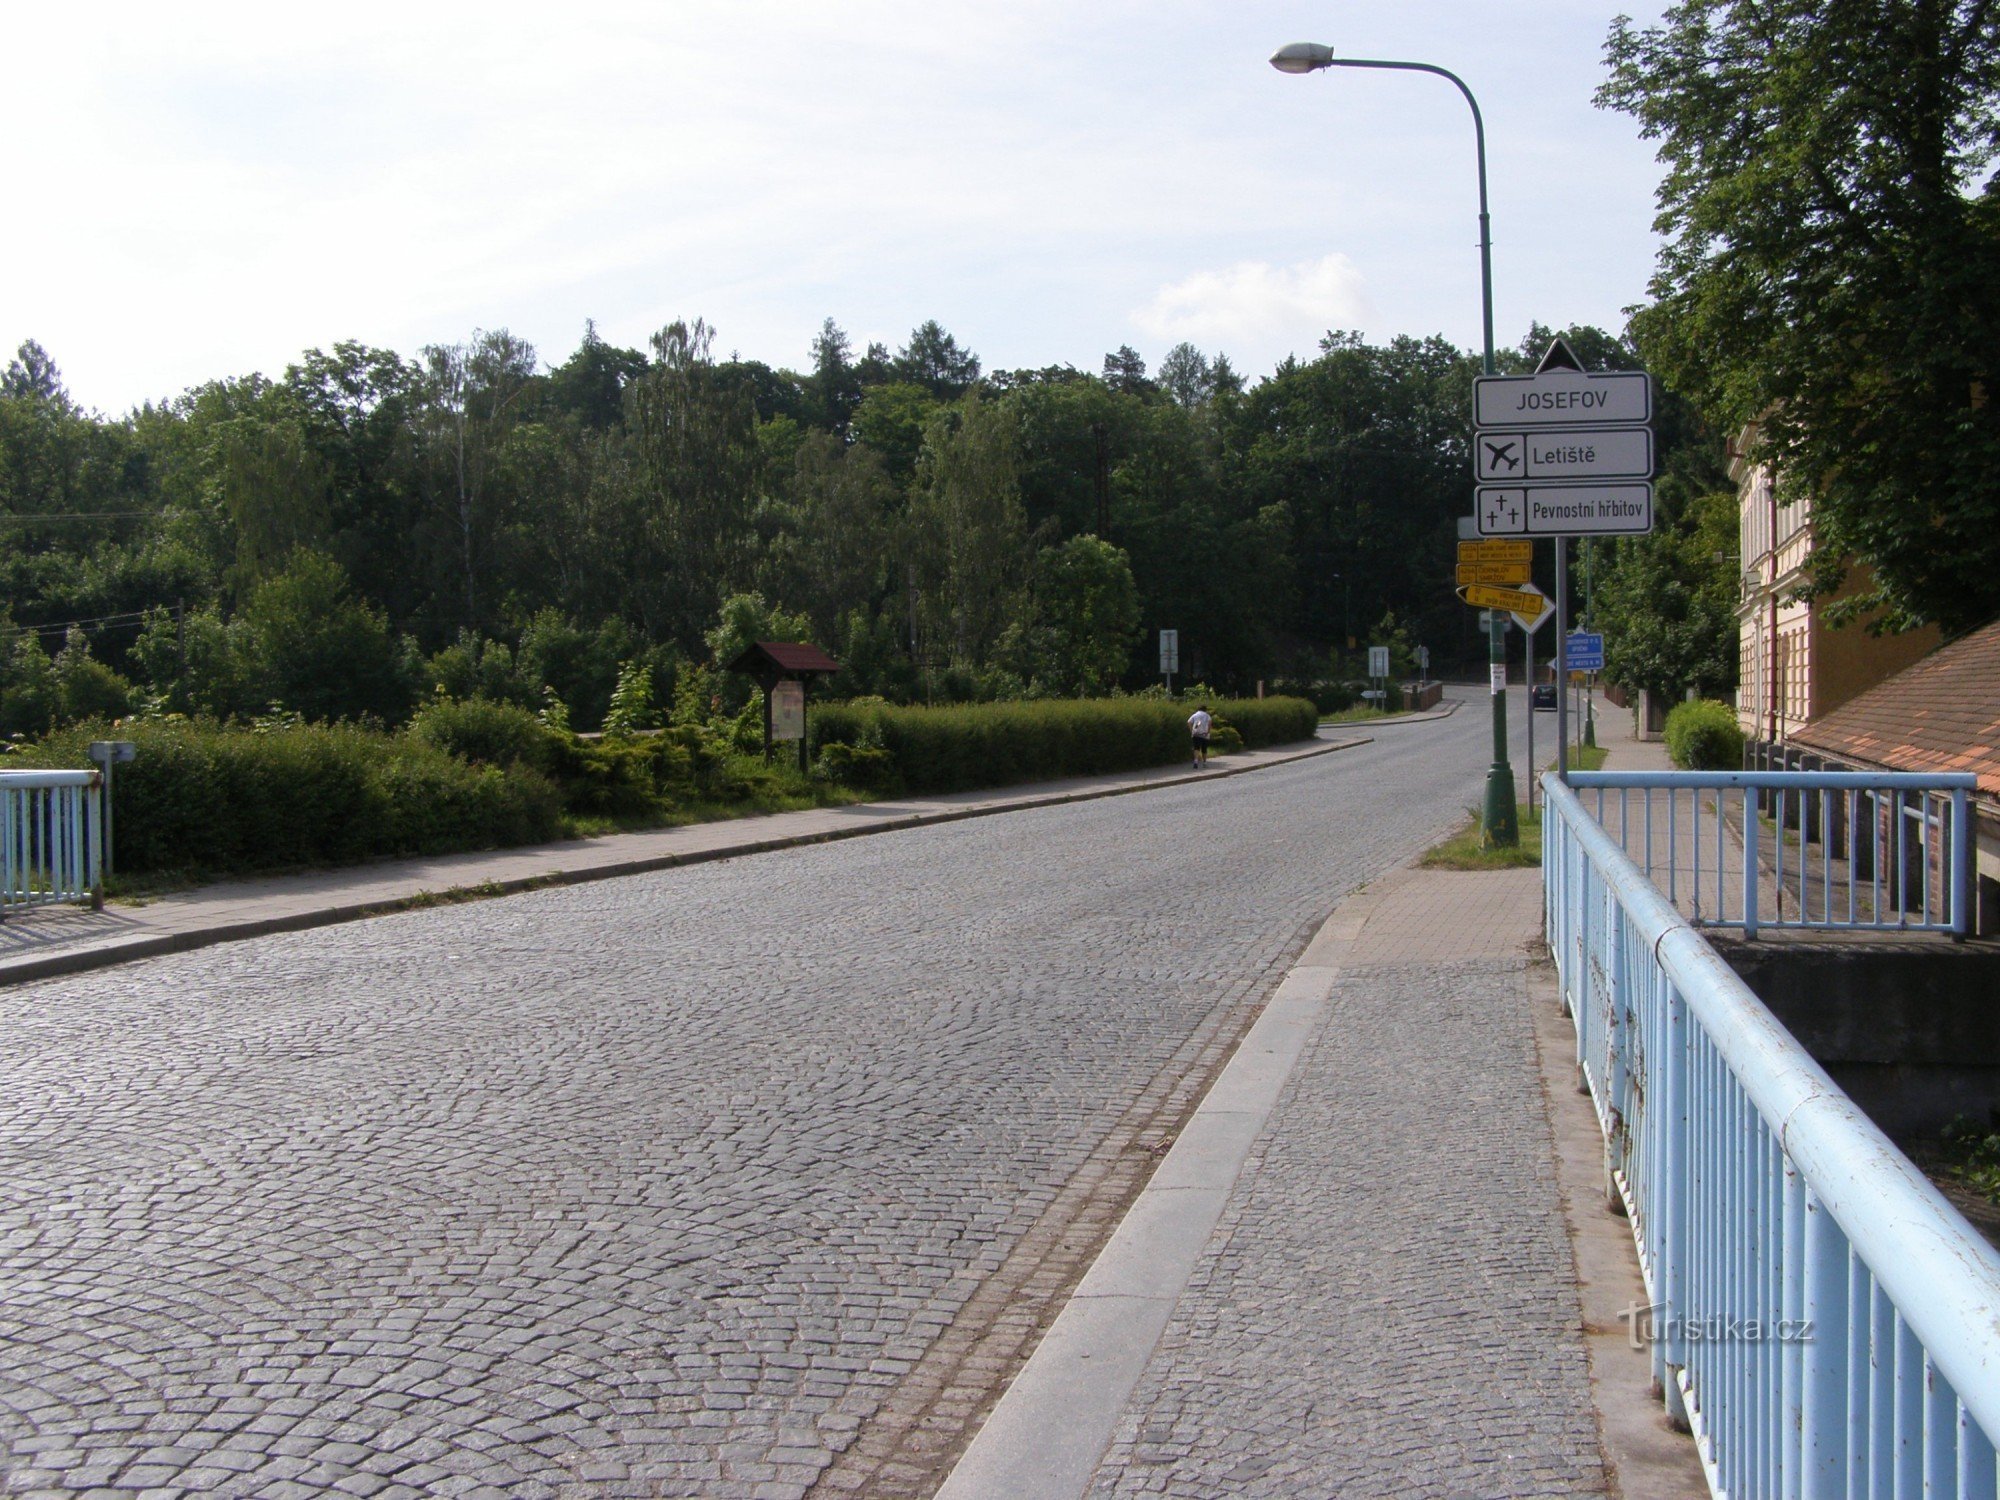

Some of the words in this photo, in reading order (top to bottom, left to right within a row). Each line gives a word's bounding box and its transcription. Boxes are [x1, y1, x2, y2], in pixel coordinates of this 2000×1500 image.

[1516, 390, 1608, 411] JOSEFOV
[1533, 446, 1596, 465] Letiště
[1533, 500, 1595, 520] Pevnostní
[1598, 499, 1643, 518] hřbitov
